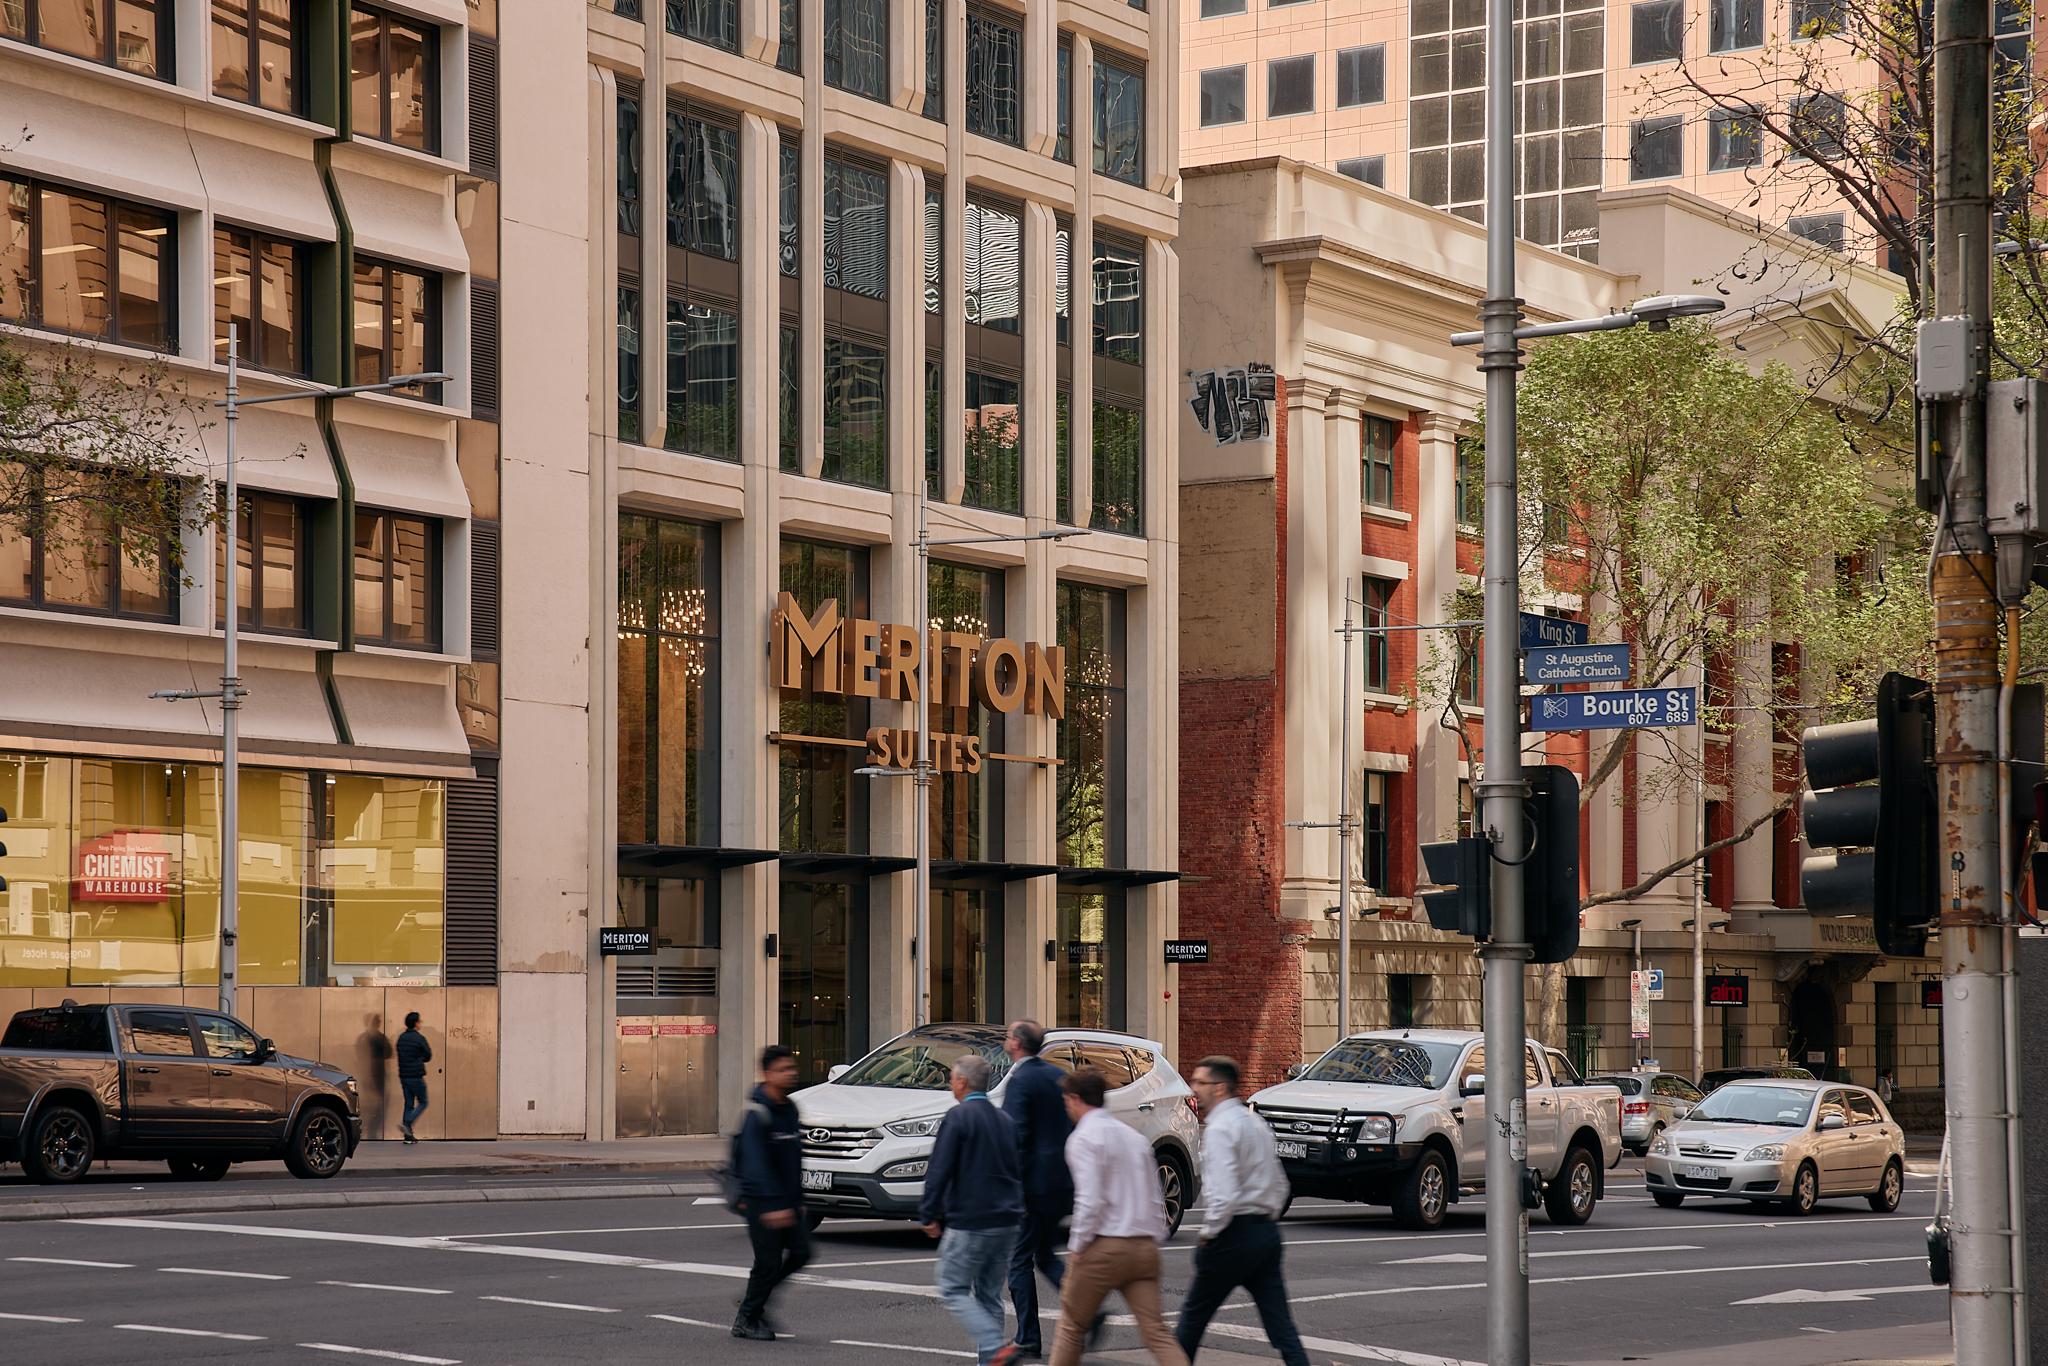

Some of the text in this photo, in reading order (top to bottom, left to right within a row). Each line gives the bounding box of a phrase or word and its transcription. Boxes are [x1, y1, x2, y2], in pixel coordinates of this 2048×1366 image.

[1539, 618, 1577, 646] King St
[770, 591, 1066, 720] MERITON
[1545, 652, 1614, 667] St Augustine
[1538, 664, 1622, 680] Catholic Church
[1583, 690, 1690, 717] Bourke St
[1628, 712, 1651, 725] 607
[1666, 711, 1689, 724] 689
[865, 726, 982, 774] SUTES
[85, 853, 164, 878] CHEMIST
[85, 880, 161, 893] WAREHOUSE
[602, 932, 649, 944] MERITON
[1166, 943, 1207, 954] MERITON
[815, 1173, 830, 1184] 274
